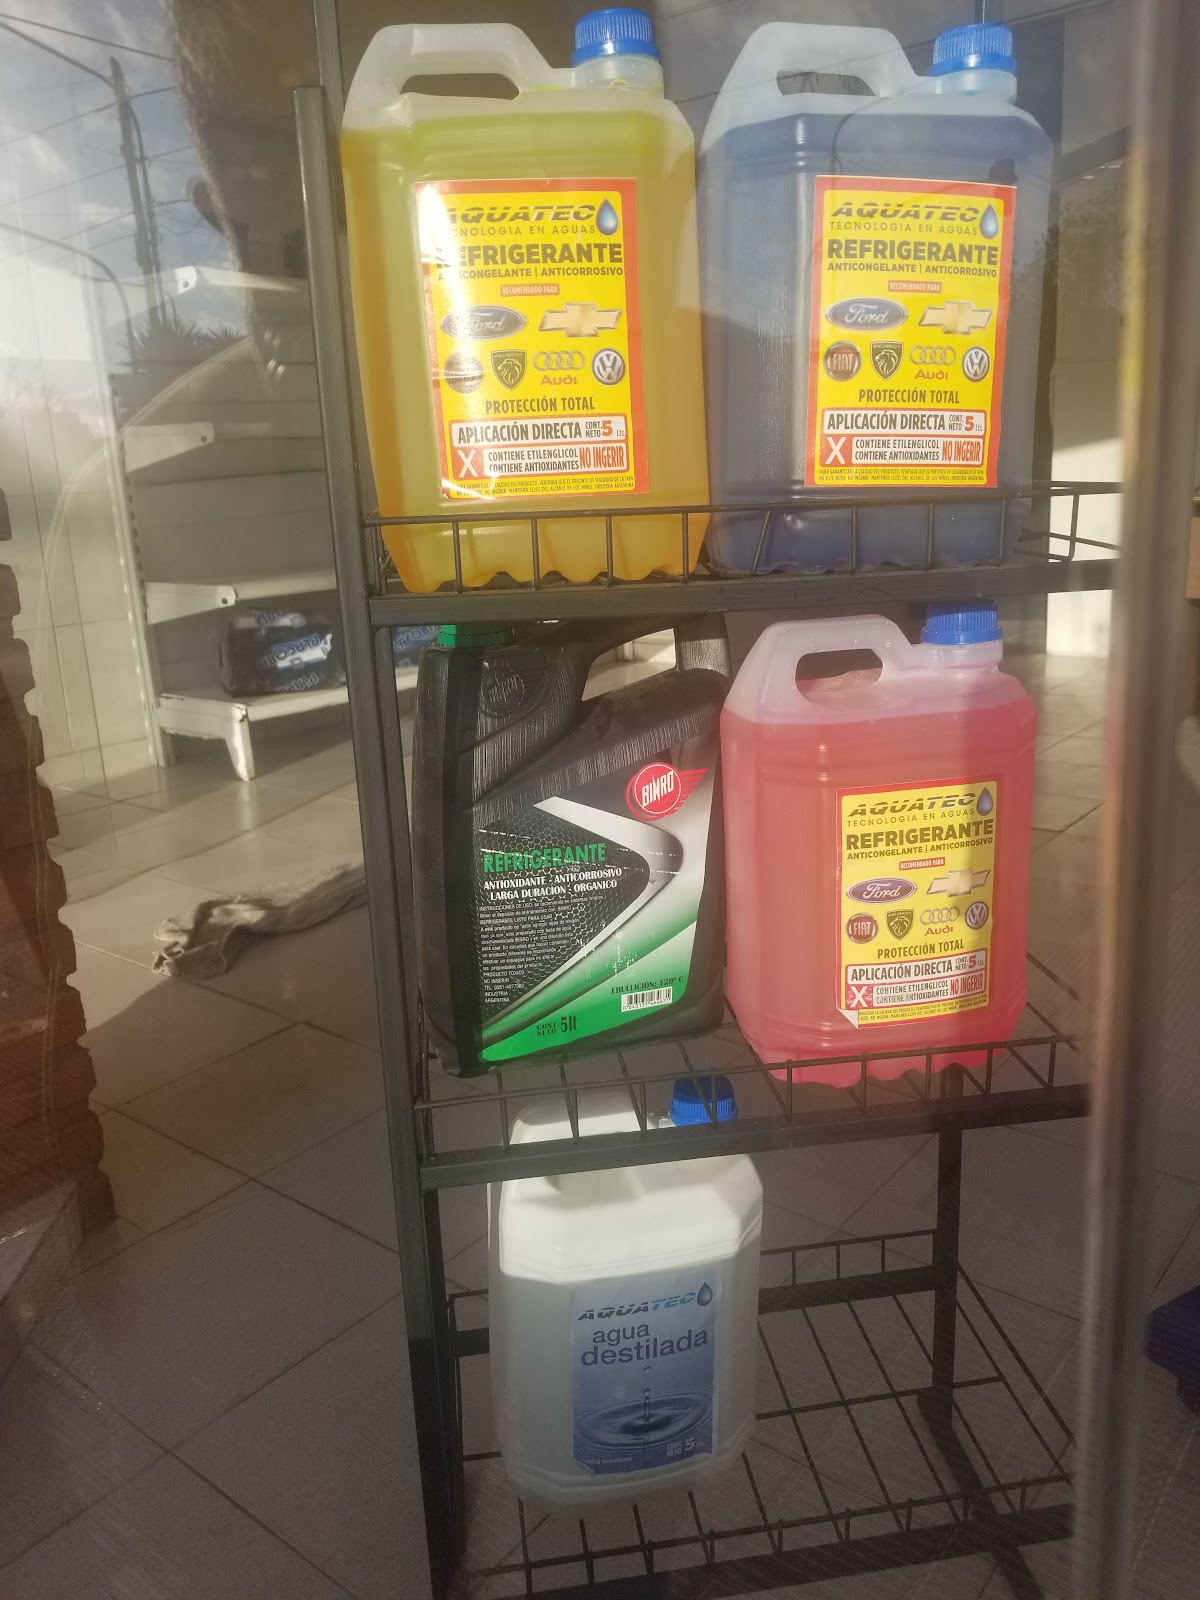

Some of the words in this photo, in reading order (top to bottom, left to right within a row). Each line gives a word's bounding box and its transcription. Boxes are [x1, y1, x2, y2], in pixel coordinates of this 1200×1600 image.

[831, 201, 980, 223] AQUATEC
[529, 226, 544, 235] EN
[552, 225, 595, 234] AGUAS
[830, 221, 912, 232] TECNOLOGIA
[918, 223, 933, 233] EN
[939, 225, 978, 236] AGUAS
[827, 238, 999, 266] REFRIGERANTE
[541, 267, 623, 277] ANTICORROSIVO
[827, 262, 917, 273] ANTICONGELANTE
[925, 265, 998, 278] ANTICORROSIVO
[502, 285, 542, 295] RECOMENDADO
[543, 285, 558, 294] PARA
[889, 282, 926, 292] RECOMENDADO
[927, 283, 941, 292] PARA
[844, 302, 890, 324] Ford
[833, 353, 854, 371] FIAT
[540, 374, 577, 386] Audi
[914, 368, 948, 380] Audi
[859, 387, 926, 403] PROTECCIÓN
[930, 390, 960, 404] TOTAL
[485, 396, 557, 415] PROTECCIÓN
[561, 396, 595, 411] TOTAL
[585, 420, 603, 430] CONT.
[601, 419, 613, 437] 5
[827, 410, 898, 430] APLICACIÓN
[900, 413, 946, 430] DIRECTA
[948, 414, 964, 423] CONT.
[964, 415, 975, 432] 5
[948, 422, 963, 431] NETO
[457, 421, 529, 444] APLICACIÓN
[532, 421, 583, 440] DIRECTA
[585, 429, 601, 438] NETO
[855, 439, 891, 449] CONTIENE
[892, 439, 940, 449] ETILENGLICOL
[941, 440, 953, 462] NO
[953, 440, 981, 462] INGERIR
[488, 450, 525, 462] CONTIENE
[527, 448, 578, 460] ETILENGLICOL
[579, 446, 592, 469] NO
[592, 445, 625, 469] INGERIR
[855, 450, 887, 461] CONTIENE
[888, 450, 940, 461] ANTIOXIDANTES
[489, 461, 523, 474] CONTIENE
[524, 460, 580, 472] ANTIOXIDANTES
[641, 770, 674, 808] BINRO
[847, 792, 976, 817] AQUATEC
[847, 814, 917, 827] TECNOLOGIA
[923, 812, 935, 821] EN
[940, 808, 975, 819] AGUAS
[846, 818, 994, 851] REFRIGERANTE
[846, 846, 923, 860] ANTICONGELANTE
[930, 836, 993, 852] ANTICORROSIVO
[483, 842, 606, 873] REFRIGERANTE
[900, 860, 932, 870] RECOMENDADO
[932, 858, 945, 867] PARA
[483, 875, 548, 890] ANTIOXIDANTE
[554, 867, 623, 884] ANTICORROSIVO
[490, 889, 520, 901] LARGA
[521, 884, 567, 899] DURACION
[573, 879, 618, 893] ORGANICO
[862, 882, 902, 899] Ford
[853, 921, 872, 936] FIAT
[924, 925, 954, 936] Audi
[877, 942, 936, 959] PROTECCIÓN
[938, 938, 964, 953] TOTAL
[850, 963, 912, 982] APLICACIÓN
[913, 959, 953, 977] DIRECTA
[955, 962, 968, 971] NETO
[968, 954, 977, 969] 5
[611, 981, 657, 994] EBULLICIÓN:
[678, 975, 684, 983] C
[876, 985, 907, 995] CONTIENE
[908, 980, 949, 992] ETILENGLICOL
[950, 978, 960, 996] NO
[960, 972, 984, 995] INGERIR
[876, 994, 904, 1005] CONTIENE
[905, 988, 949, 1002] ANTIOXIDANTES
[536, 1028, 557, 1037] NETO
[560, 1015, 578, 1033] 5lt
[577, 1292, 696, 1321] AQUATEC
[592, 1323, 650, 1347] agua
[580, 1329, 709, 1366] destilada
[684, 1437, 696, 1452] 5
